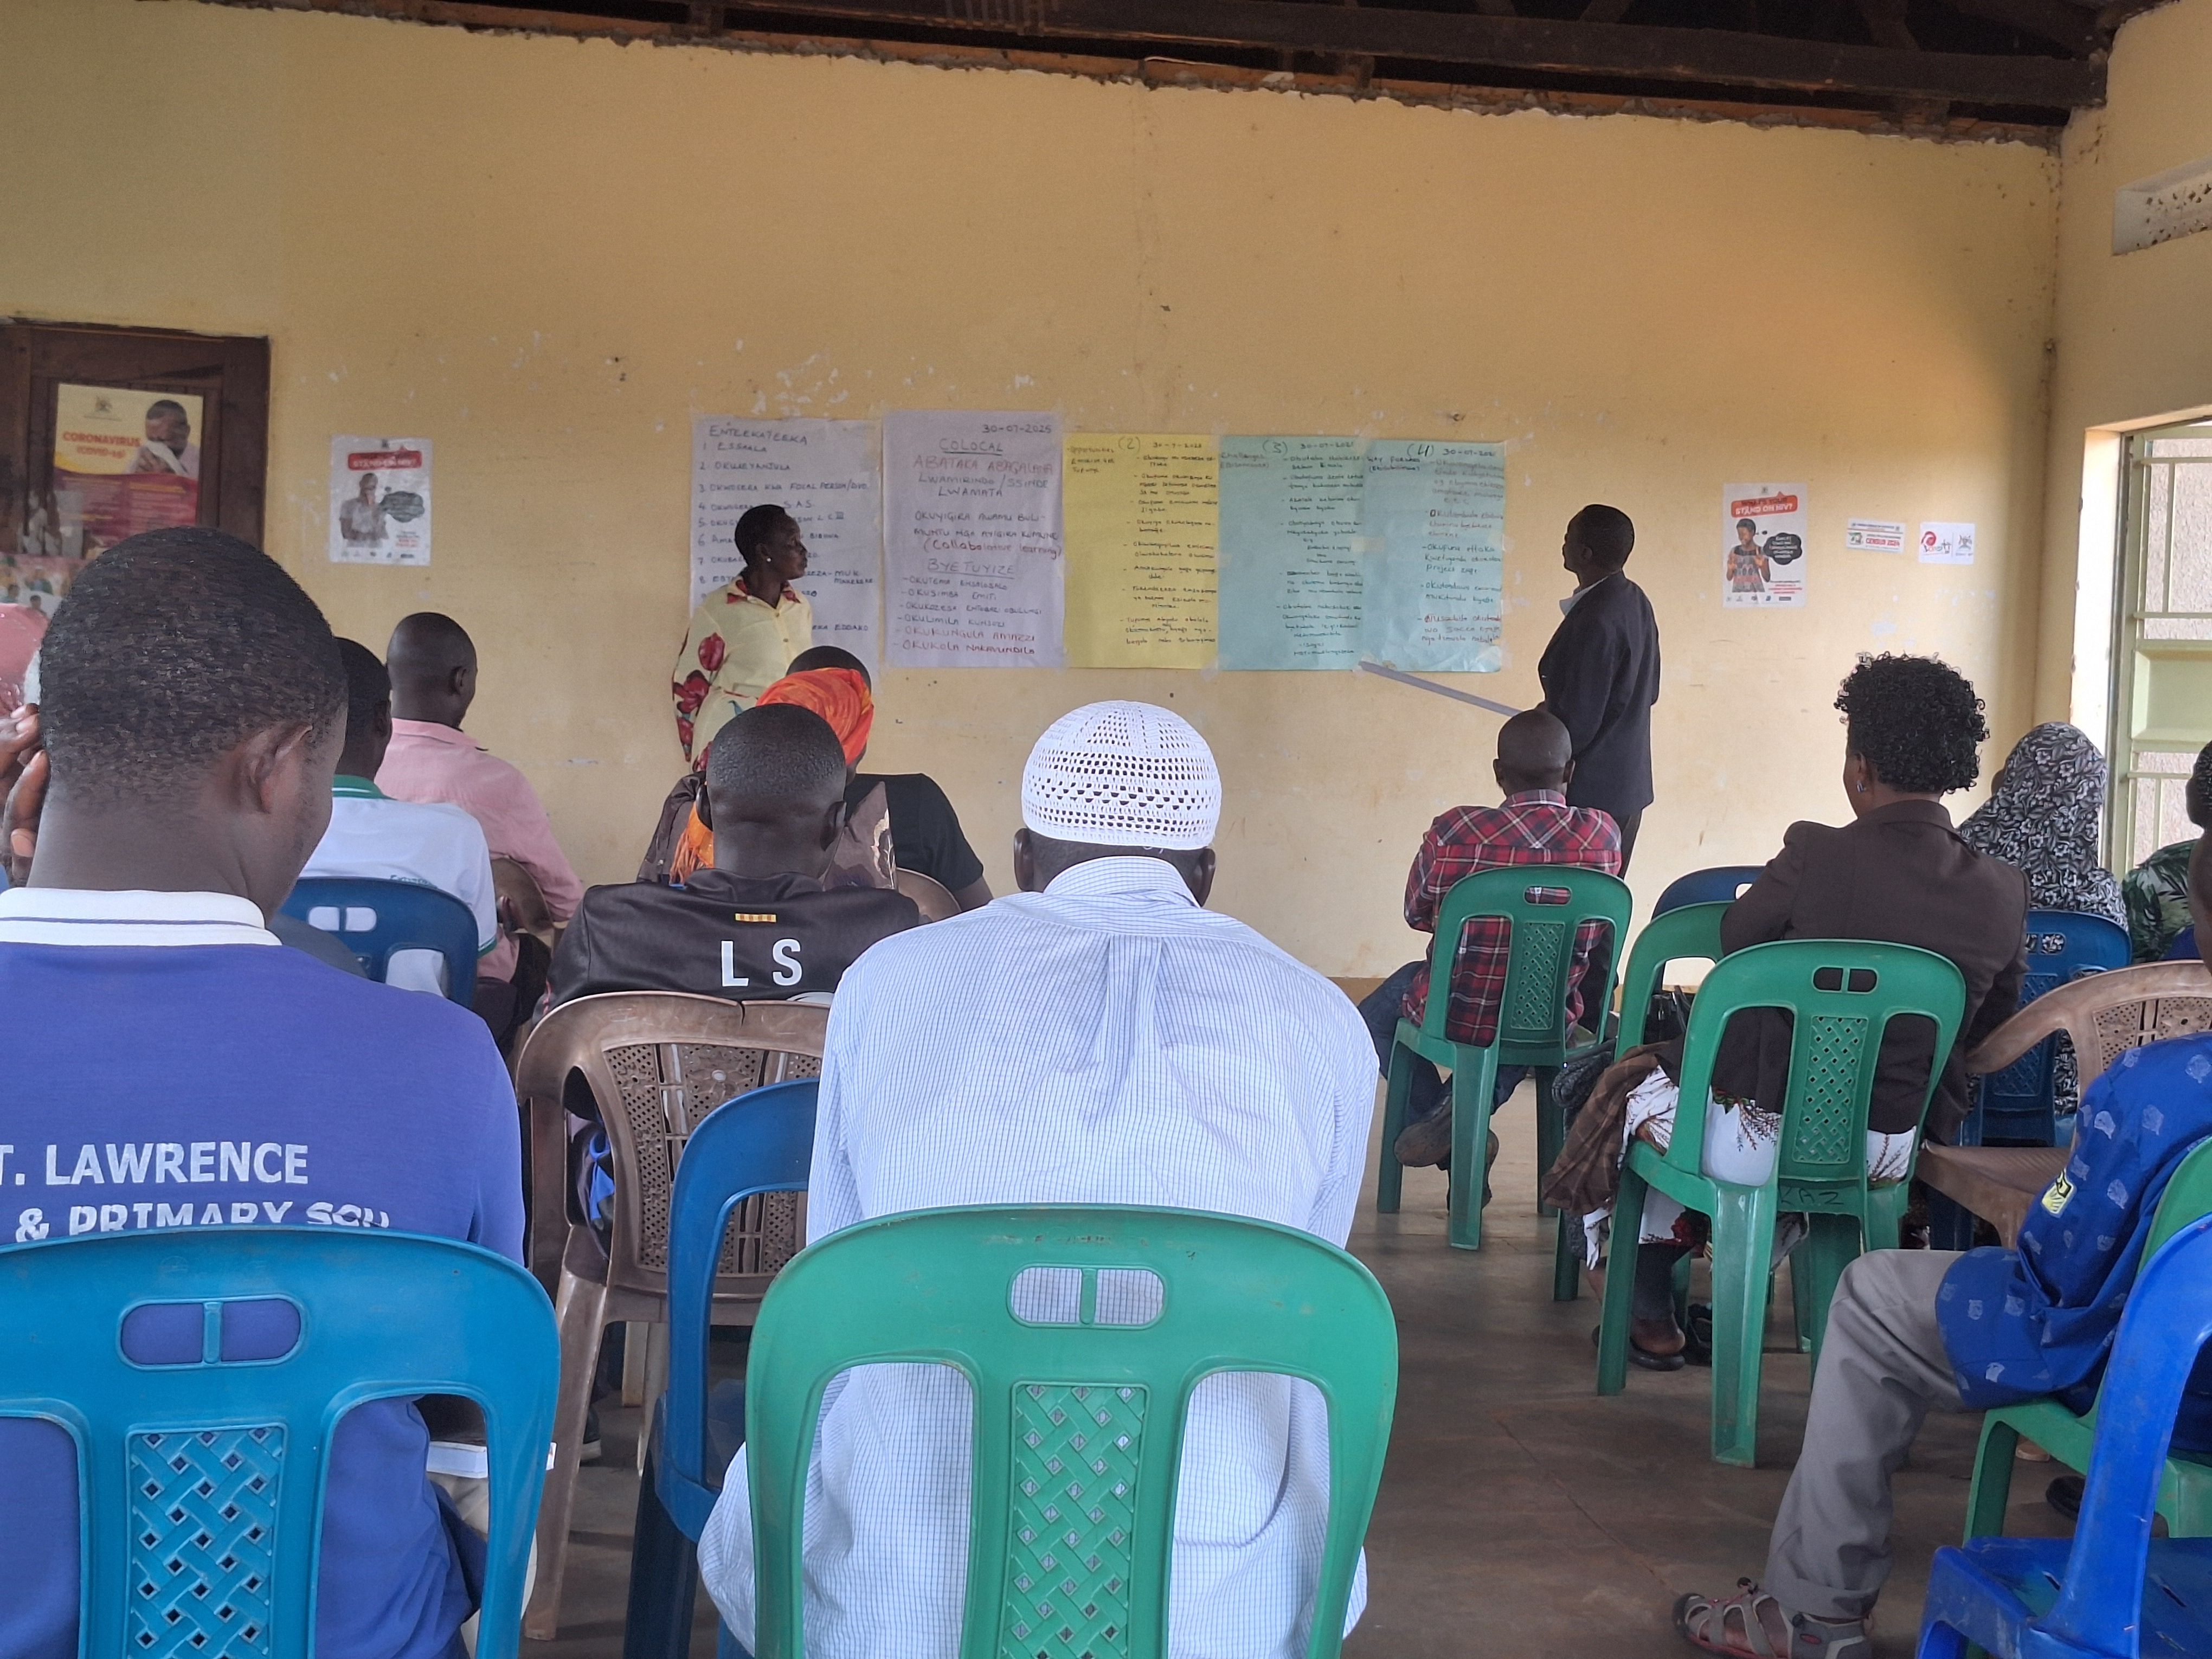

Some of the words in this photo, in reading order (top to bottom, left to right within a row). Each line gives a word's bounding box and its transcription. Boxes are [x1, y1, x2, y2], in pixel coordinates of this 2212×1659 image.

[63, 430, 140, 447] CORONAVIRUS
[939, 438, 1003, 452] COLOCAL
[46, 1142, 308, 1185] LAWRENCE
[16, 1208, 49, 1243] &
